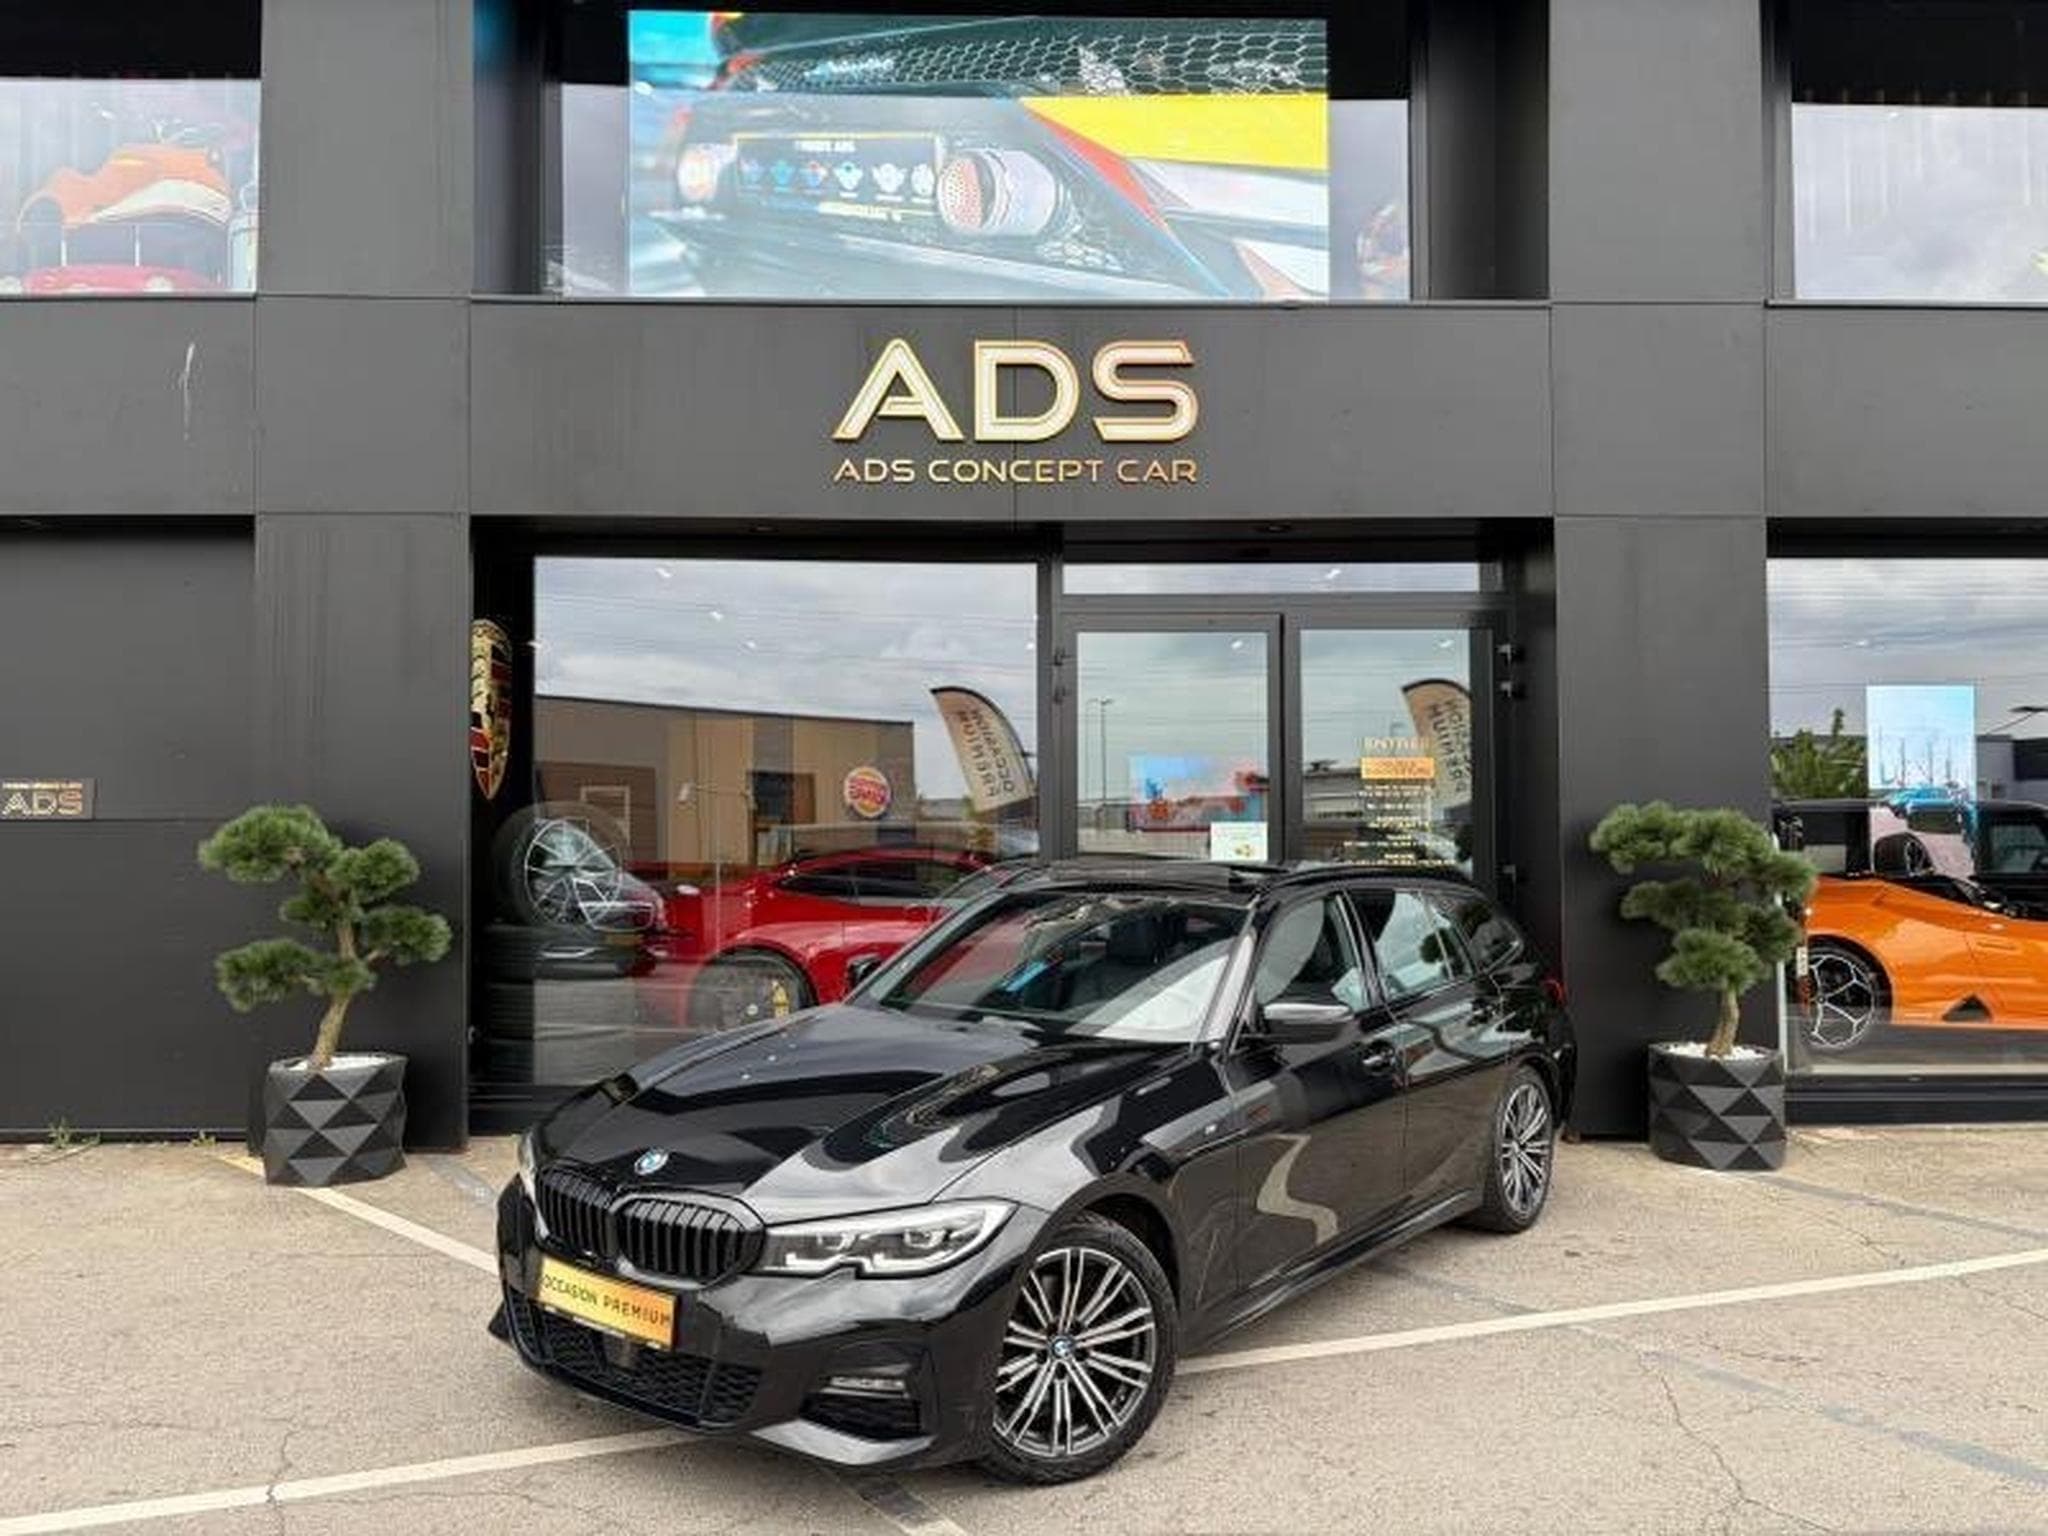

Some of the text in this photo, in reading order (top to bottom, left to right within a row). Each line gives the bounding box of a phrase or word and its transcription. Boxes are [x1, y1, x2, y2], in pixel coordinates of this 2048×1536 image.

[832, 338, 1198, 441] ADS
[833, 459, 1198, 482] ADS CONCEPT CAR
[2, 792, 83, 815] ADS
[602, 1294, 671, 1326] PREMIUM
